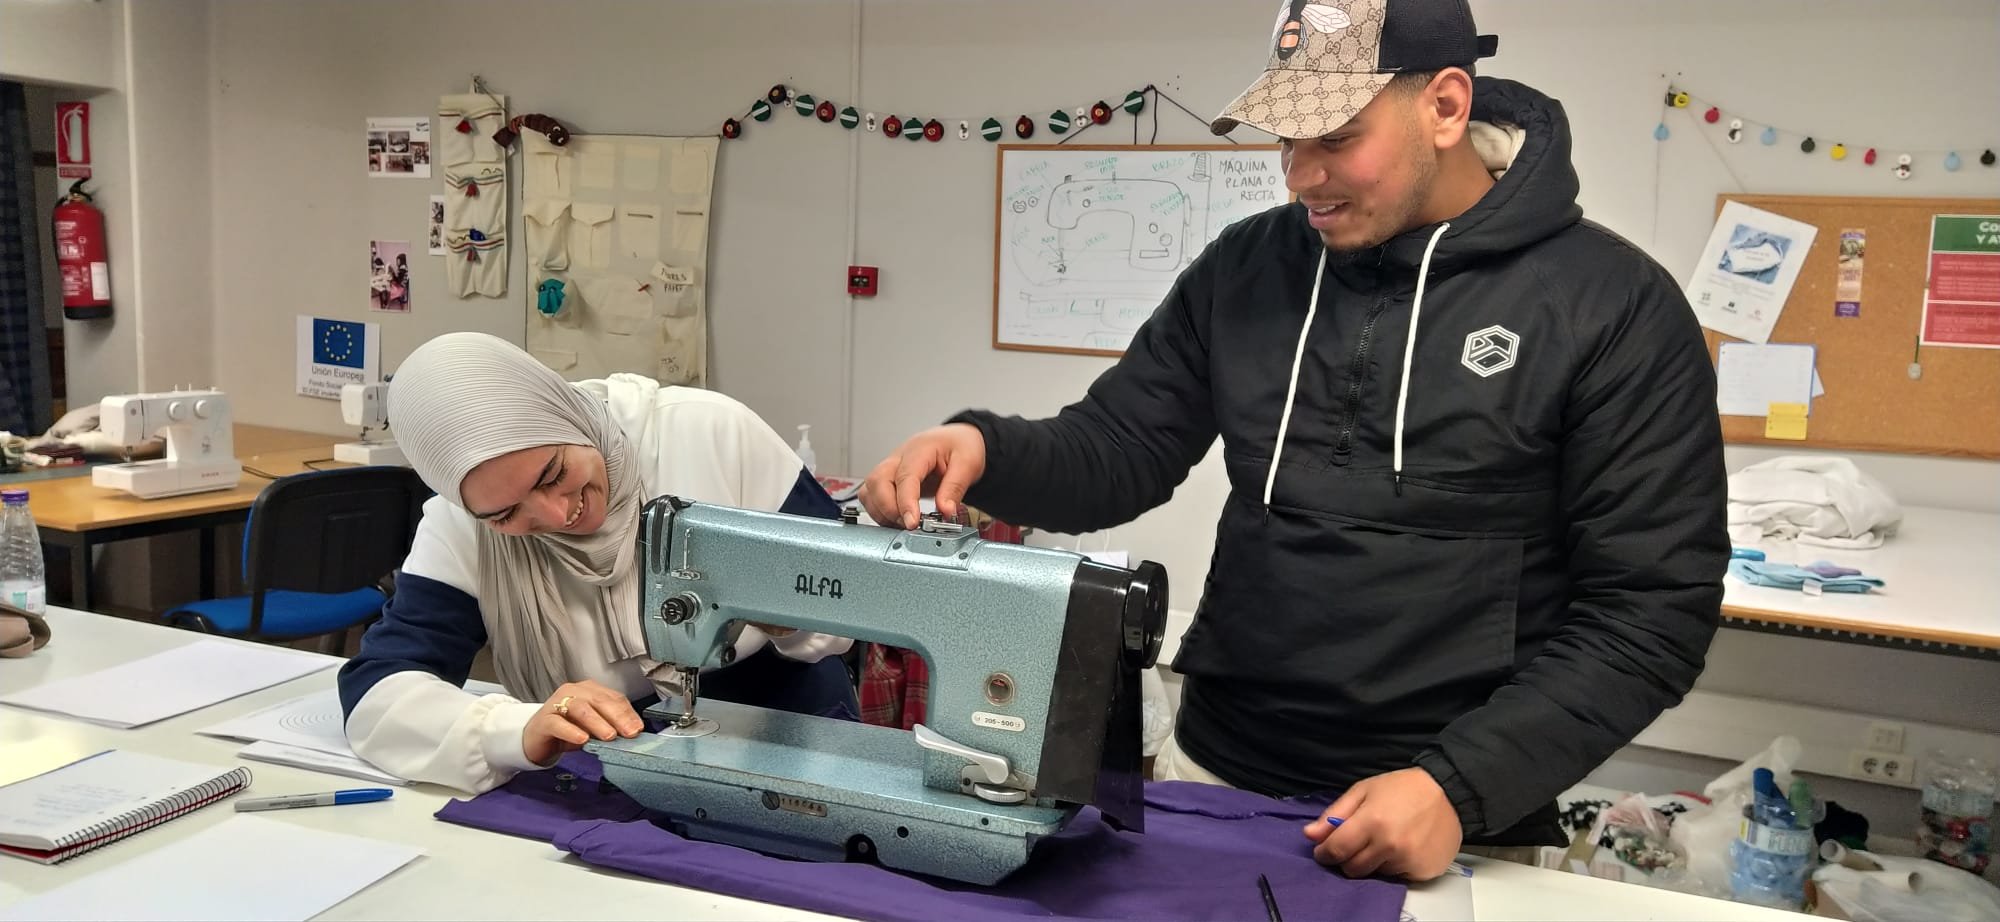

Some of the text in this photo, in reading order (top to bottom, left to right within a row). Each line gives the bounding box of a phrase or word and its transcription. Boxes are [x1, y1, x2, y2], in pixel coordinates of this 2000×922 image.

[1225, 175, 1277, 188] PLANA O
[1240, 190, 1275, 201] RECTA
[1976, 234, 1986, 245] Y
